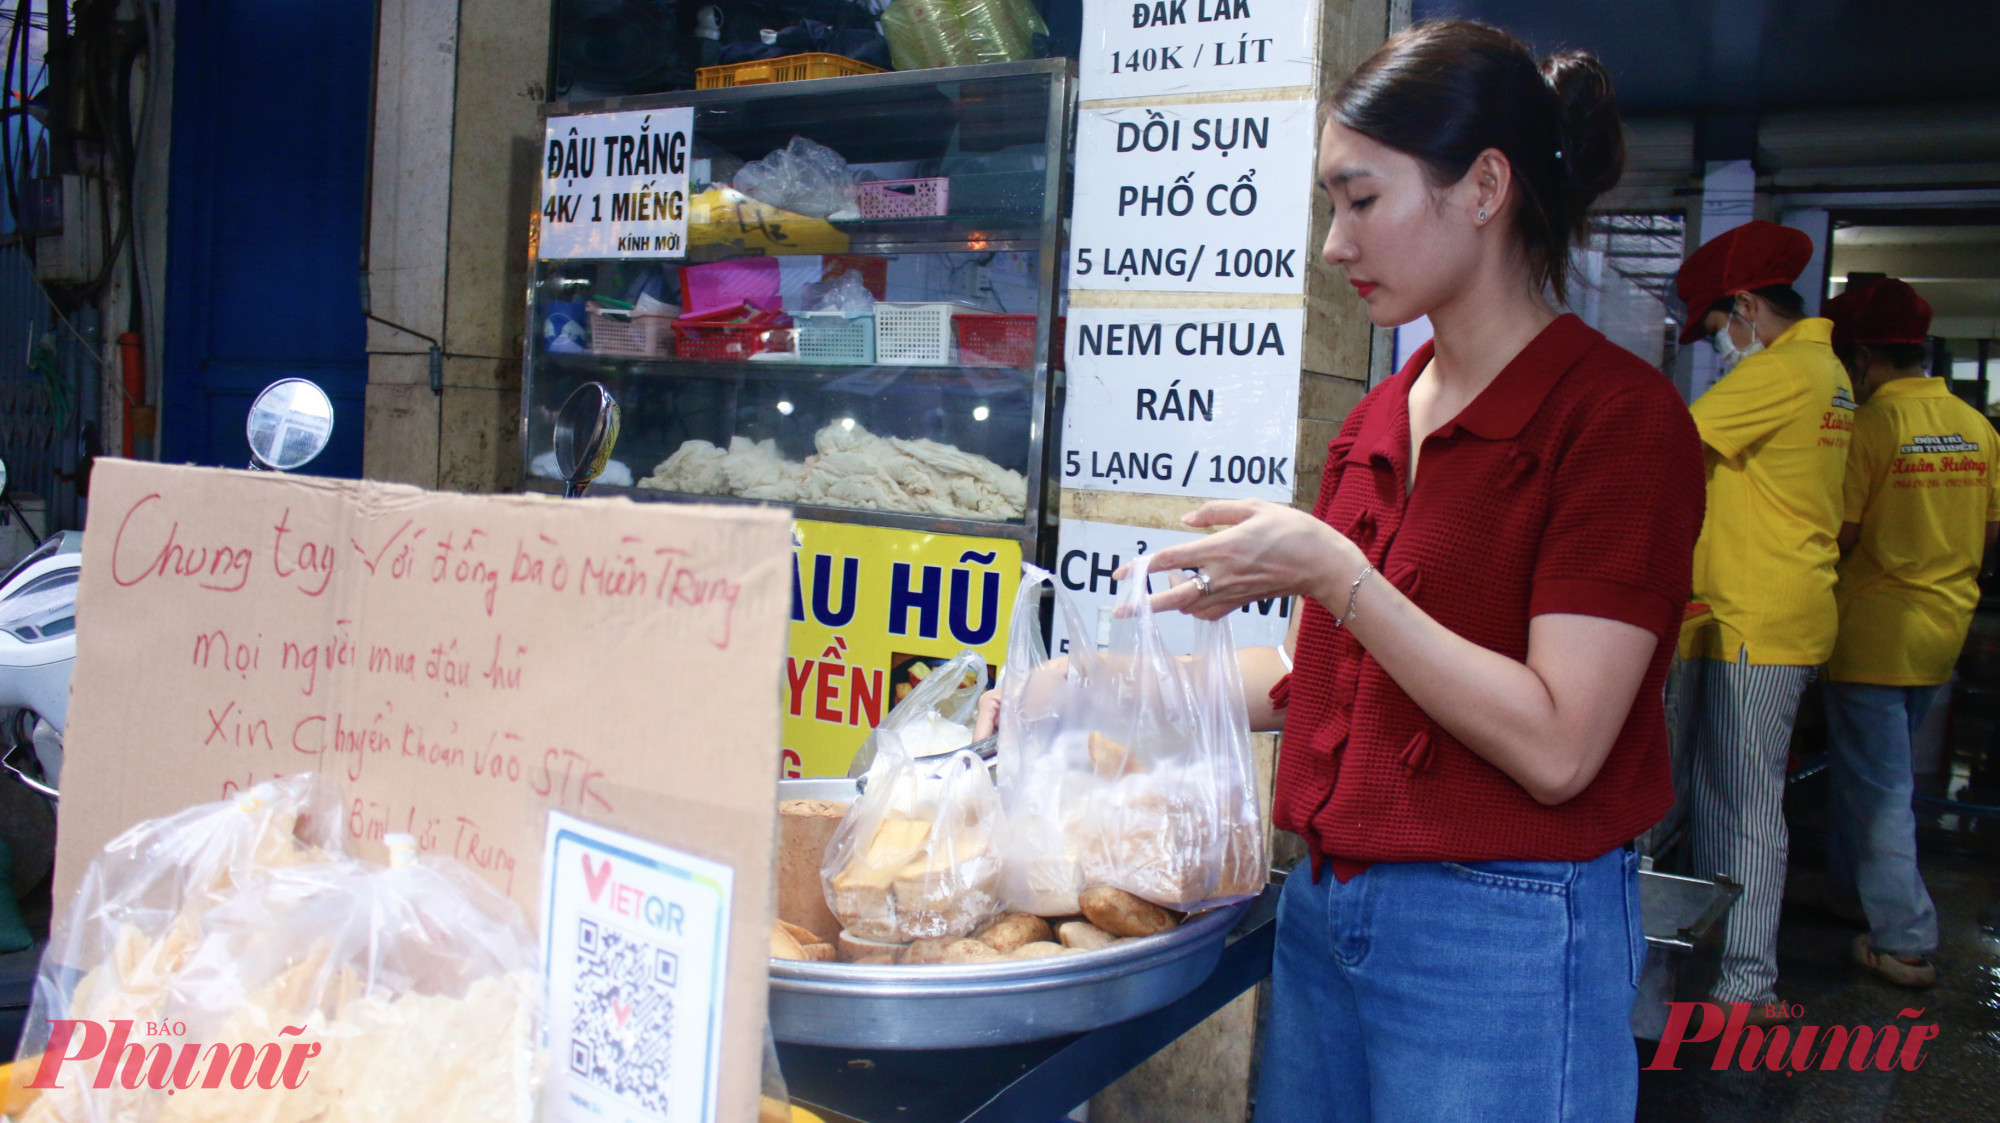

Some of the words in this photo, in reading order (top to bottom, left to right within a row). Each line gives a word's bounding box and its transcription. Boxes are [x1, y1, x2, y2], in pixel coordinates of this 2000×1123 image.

[1110, 45, 1184, 74] 140K
[1193, 43, 1204, 68] /
[1213, 32, 1273, 66] LÍT
[547, 127, 596, 188] ĐẬU
[604, 114, 686, 177] TRẮNG
[1116, 108, 1180, 153] DỒI
[1191, 116, 1269, 158] SỤN
[591, 194, 602, 222] 1
[611, 180, 684, 222] MIẾNG
[1118, 171, 1196, 217] PHỐ
[1206, 168, 1258, 217] CỔ
[617, 232, 650, 251] KÍNH
[655, 232, 680, 251] MỜI
[1076, 248, 1093, 276] 5
[1215, 248, 1296, 278] 100K
[1078, 323, 1162, 356] NEM
[1175, 322, 1285, 356] CHUA
[1136, 379, 1214, 422] RÁN
[1065, 450, 1081, 477] 5
[1091, 451, 1173, 485] LẠNG
[1181, 450, 1199, 488] /
[1209, 454, 1289, 486] 100K
[112, 493, 252, 592] Chung
[274, 507, 335, 596] tay
[887, 549, 1002, 647] HŨ
[368, 644, 416, 683] mua
[205, 700, 273, 751] Xin
[530, 747, 614, 812] STK
